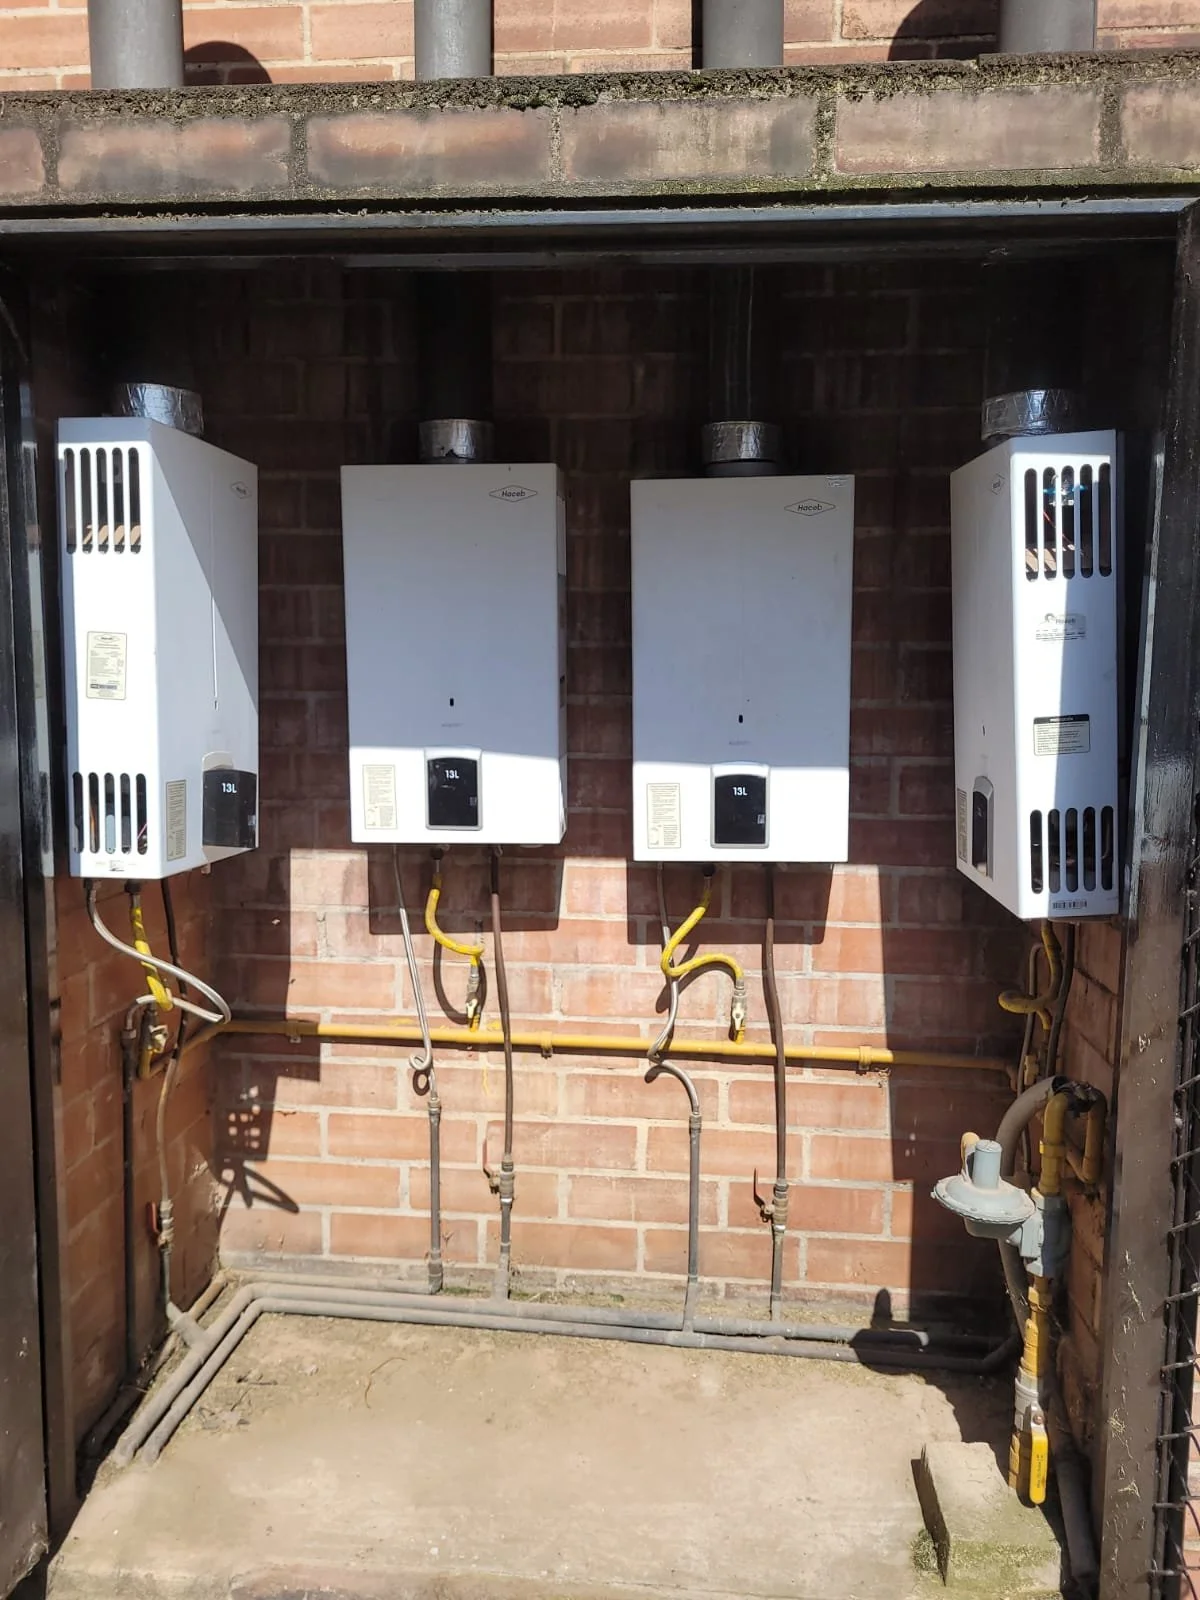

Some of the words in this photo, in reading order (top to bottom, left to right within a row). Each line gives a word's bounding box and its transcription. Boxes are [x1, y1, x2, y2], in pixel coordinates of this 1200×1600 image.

[502, 489, 526, 497] Haceb
[445, 769, 460, 779] 13L
[221, 782, 238, 793] 13L
[732, 786, 748, 796] 13L
